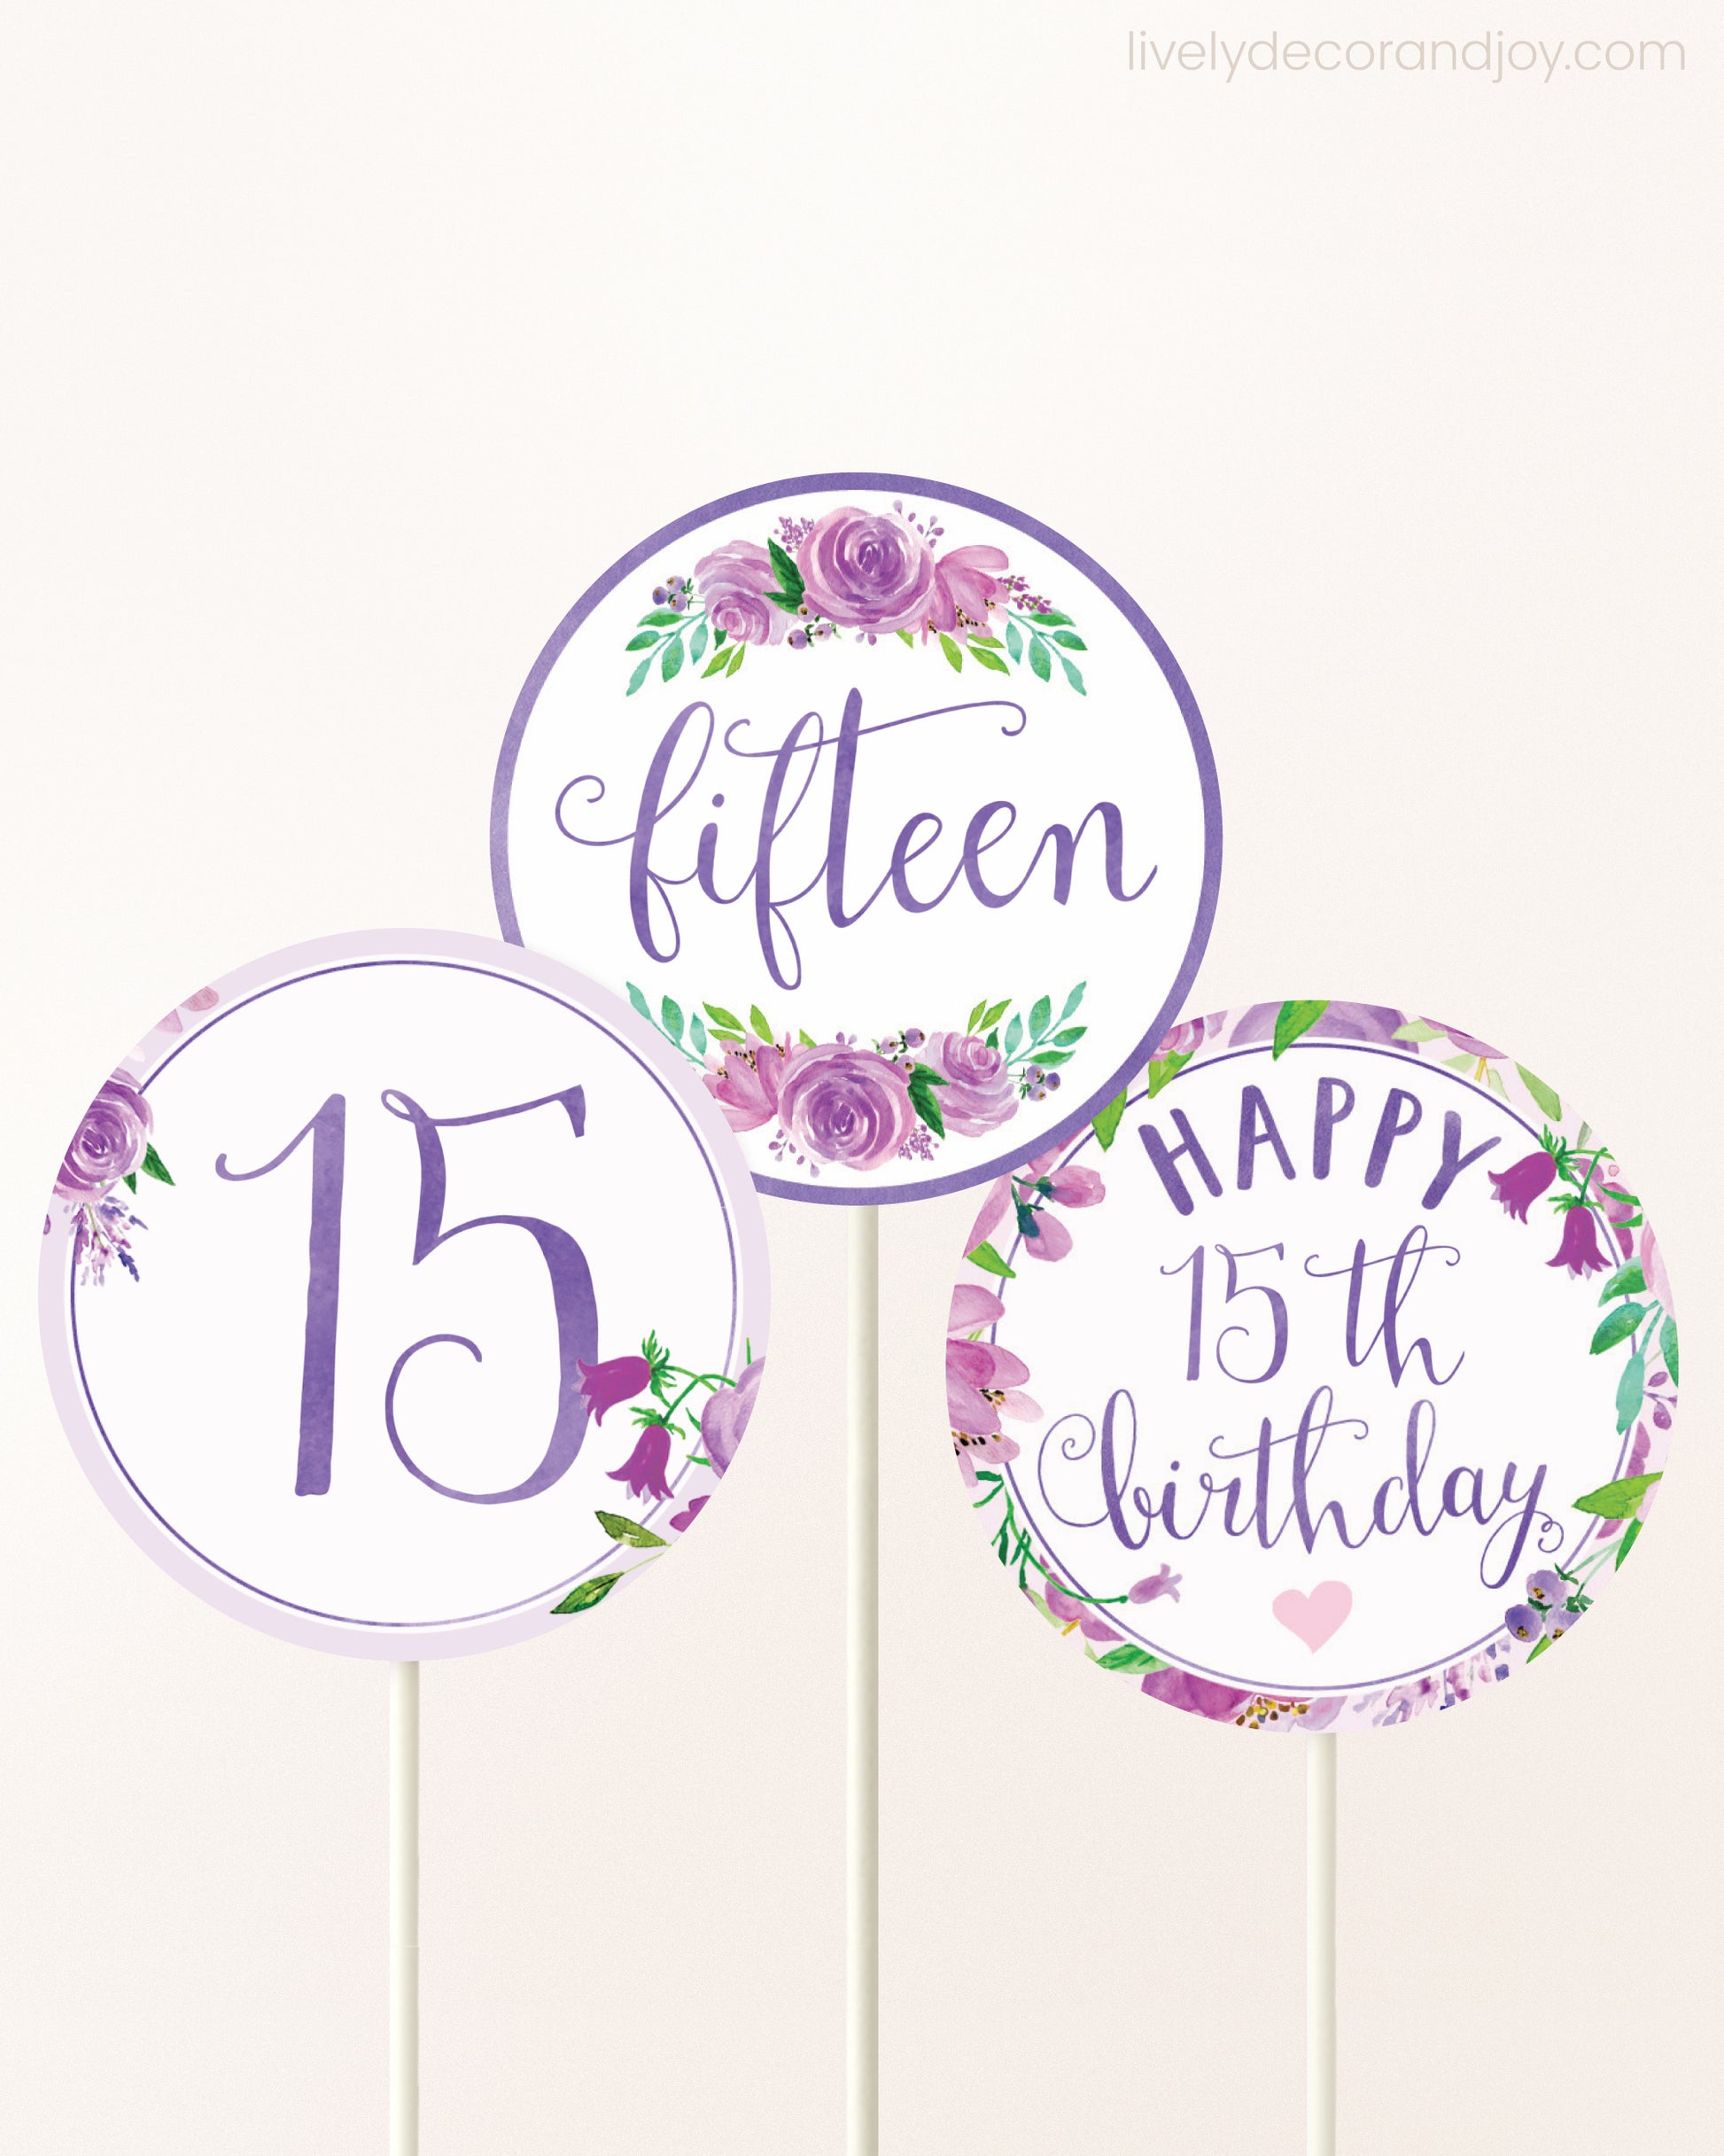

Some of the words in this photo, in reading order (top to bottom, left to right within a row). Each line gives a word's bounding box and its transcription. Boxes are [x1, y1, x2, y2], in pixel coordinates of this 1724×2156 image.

[555, 688, 1159, 990] fifteen
[1138, 1077, 1502, 1216] HAPPY
[215, 1084, 599, 1506] 15
[1037, 1385, 1565, 1589] birthday
